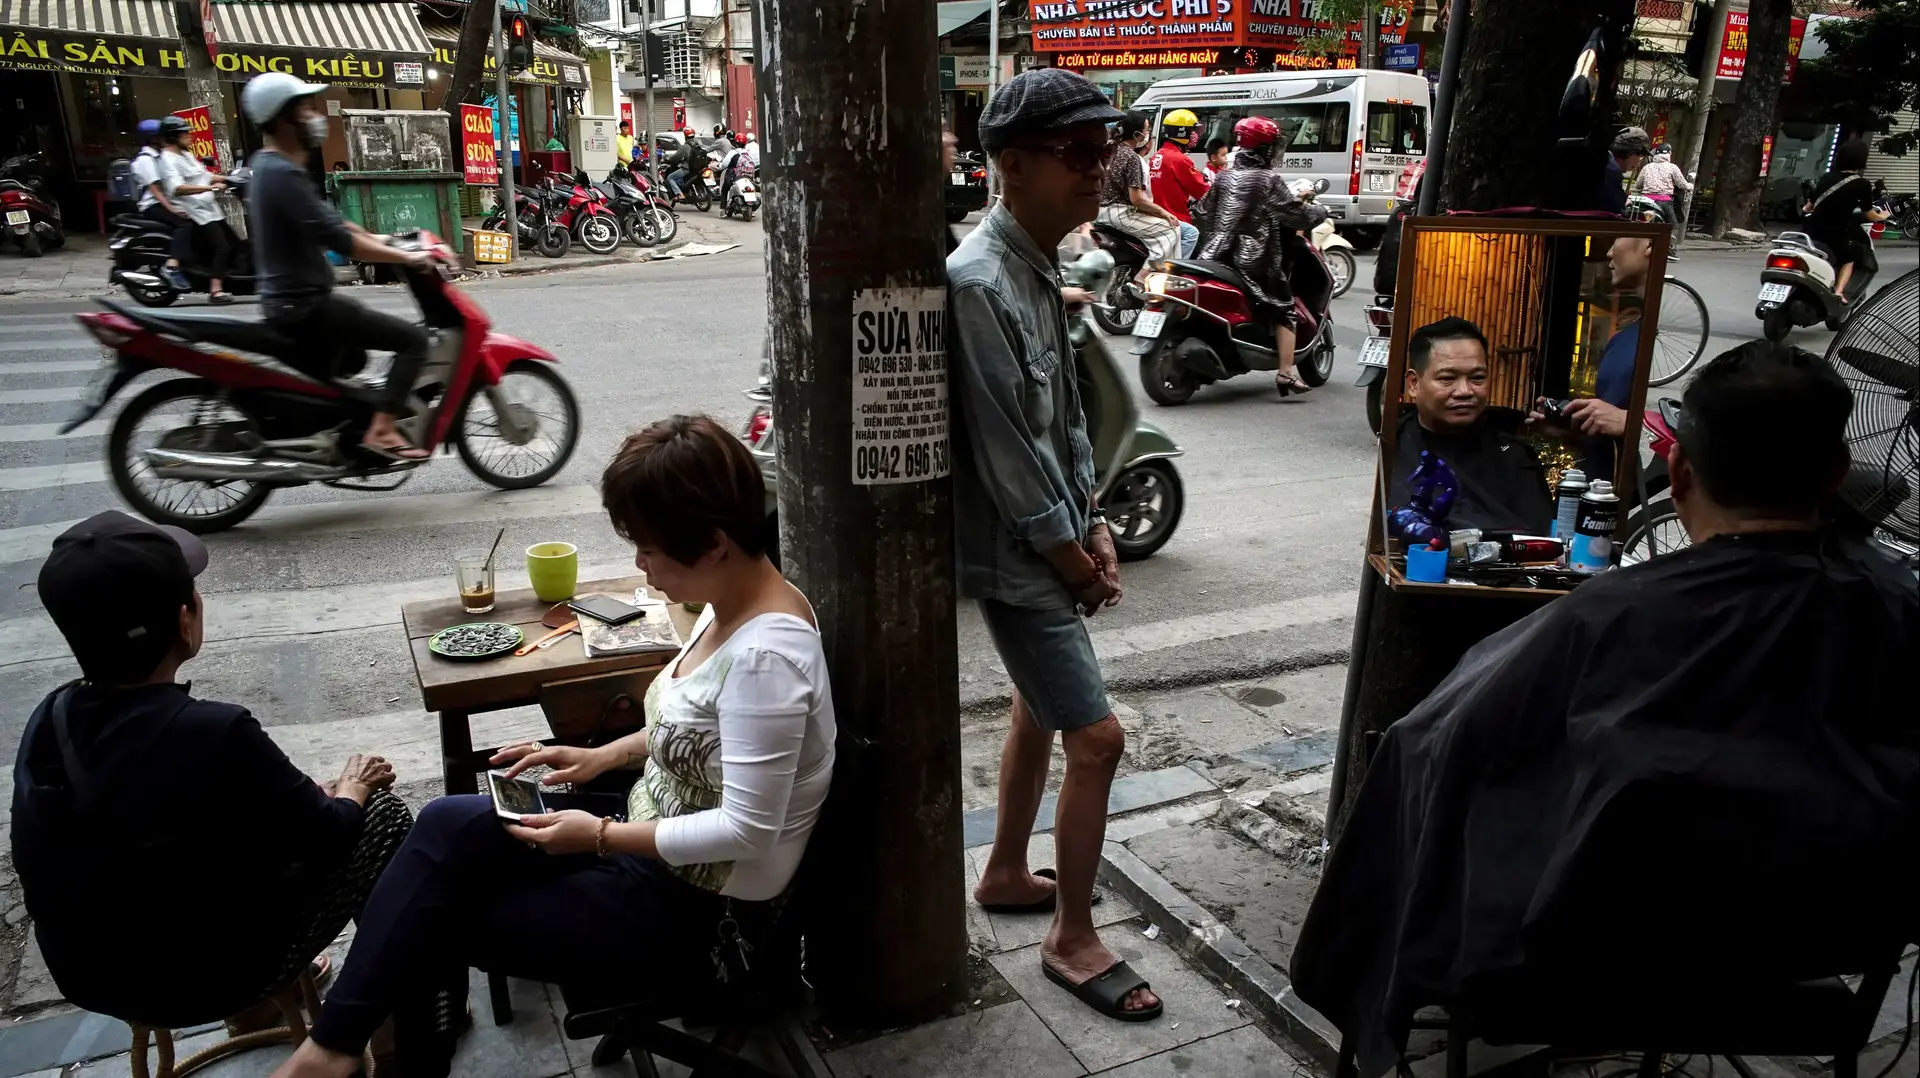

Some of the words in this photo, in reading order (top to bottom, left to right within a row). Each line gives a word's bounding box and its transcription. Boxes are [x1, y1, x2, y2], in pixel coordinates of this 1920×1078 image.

[1034, 0, 1082, 21] NHÀ
[1086, 0, 1164, 20] THUỐC
[1172, 0, 1211, 16] PHI
[1216, 0, 1231, 14] 5
[1037, 26, 1076, 39] CHUYÊN
[1080, 24, 1100, 38] BÁN
[1103, 22, 1115, 37] LẺ
[1119, 21, 1155, 36] THUỐC
[1159, 22, 1196, 34] THÀNH
[1200, 17, 1233, 33] PHẨM
[1250, 22, 1285, 35] CHUYÊN
[63, 38, 146, 67] SẢN
[160, 49, 293, 74] HƠNG
[306, 52, 384, 79] KIỀU
[1067, 53, 1084, 66] CỬA
[1086, 52, 1100, 66] TỪ
[1101, 54, 1113, 66] 6H
[1115, 51, 1136, 66] ĐẾN
[1138, 53, 1157, 65] 24H
[1160, 51, 1188, 65] HÀNG
[1190, 50, 1219, 64] NGÀY
[1275, 54, 1327, 69] PHARMACY
[1336, 56, 1357, 70] NHÀ
[959, 69, 979, 78] IPHONE
[857, 301, 912, 355] SỬA
[858, 356, 880, 374] 0942
[882, 356, 897, 374] 696
[899, 355, 912, 373] 530
[918, 354, 932, 372] 0942
[863, 375, 879, 388] XÂY
[880, 375, 895, 388] NHÀ
[901, 388, 918, 400] THÊM
[861, 400, 888, 414] CHỐNG
[864, 415, 882, 430] ĐIỆN
[855, 429, 877, 443] NHẬN
[879, 430, 891, 440] THI
[892, 428, 911, 440] CÔNG
[857, 445, 900, 480] 0942
[904, 442, 930, 478] 696
[932, 438, 949, 473] 530
